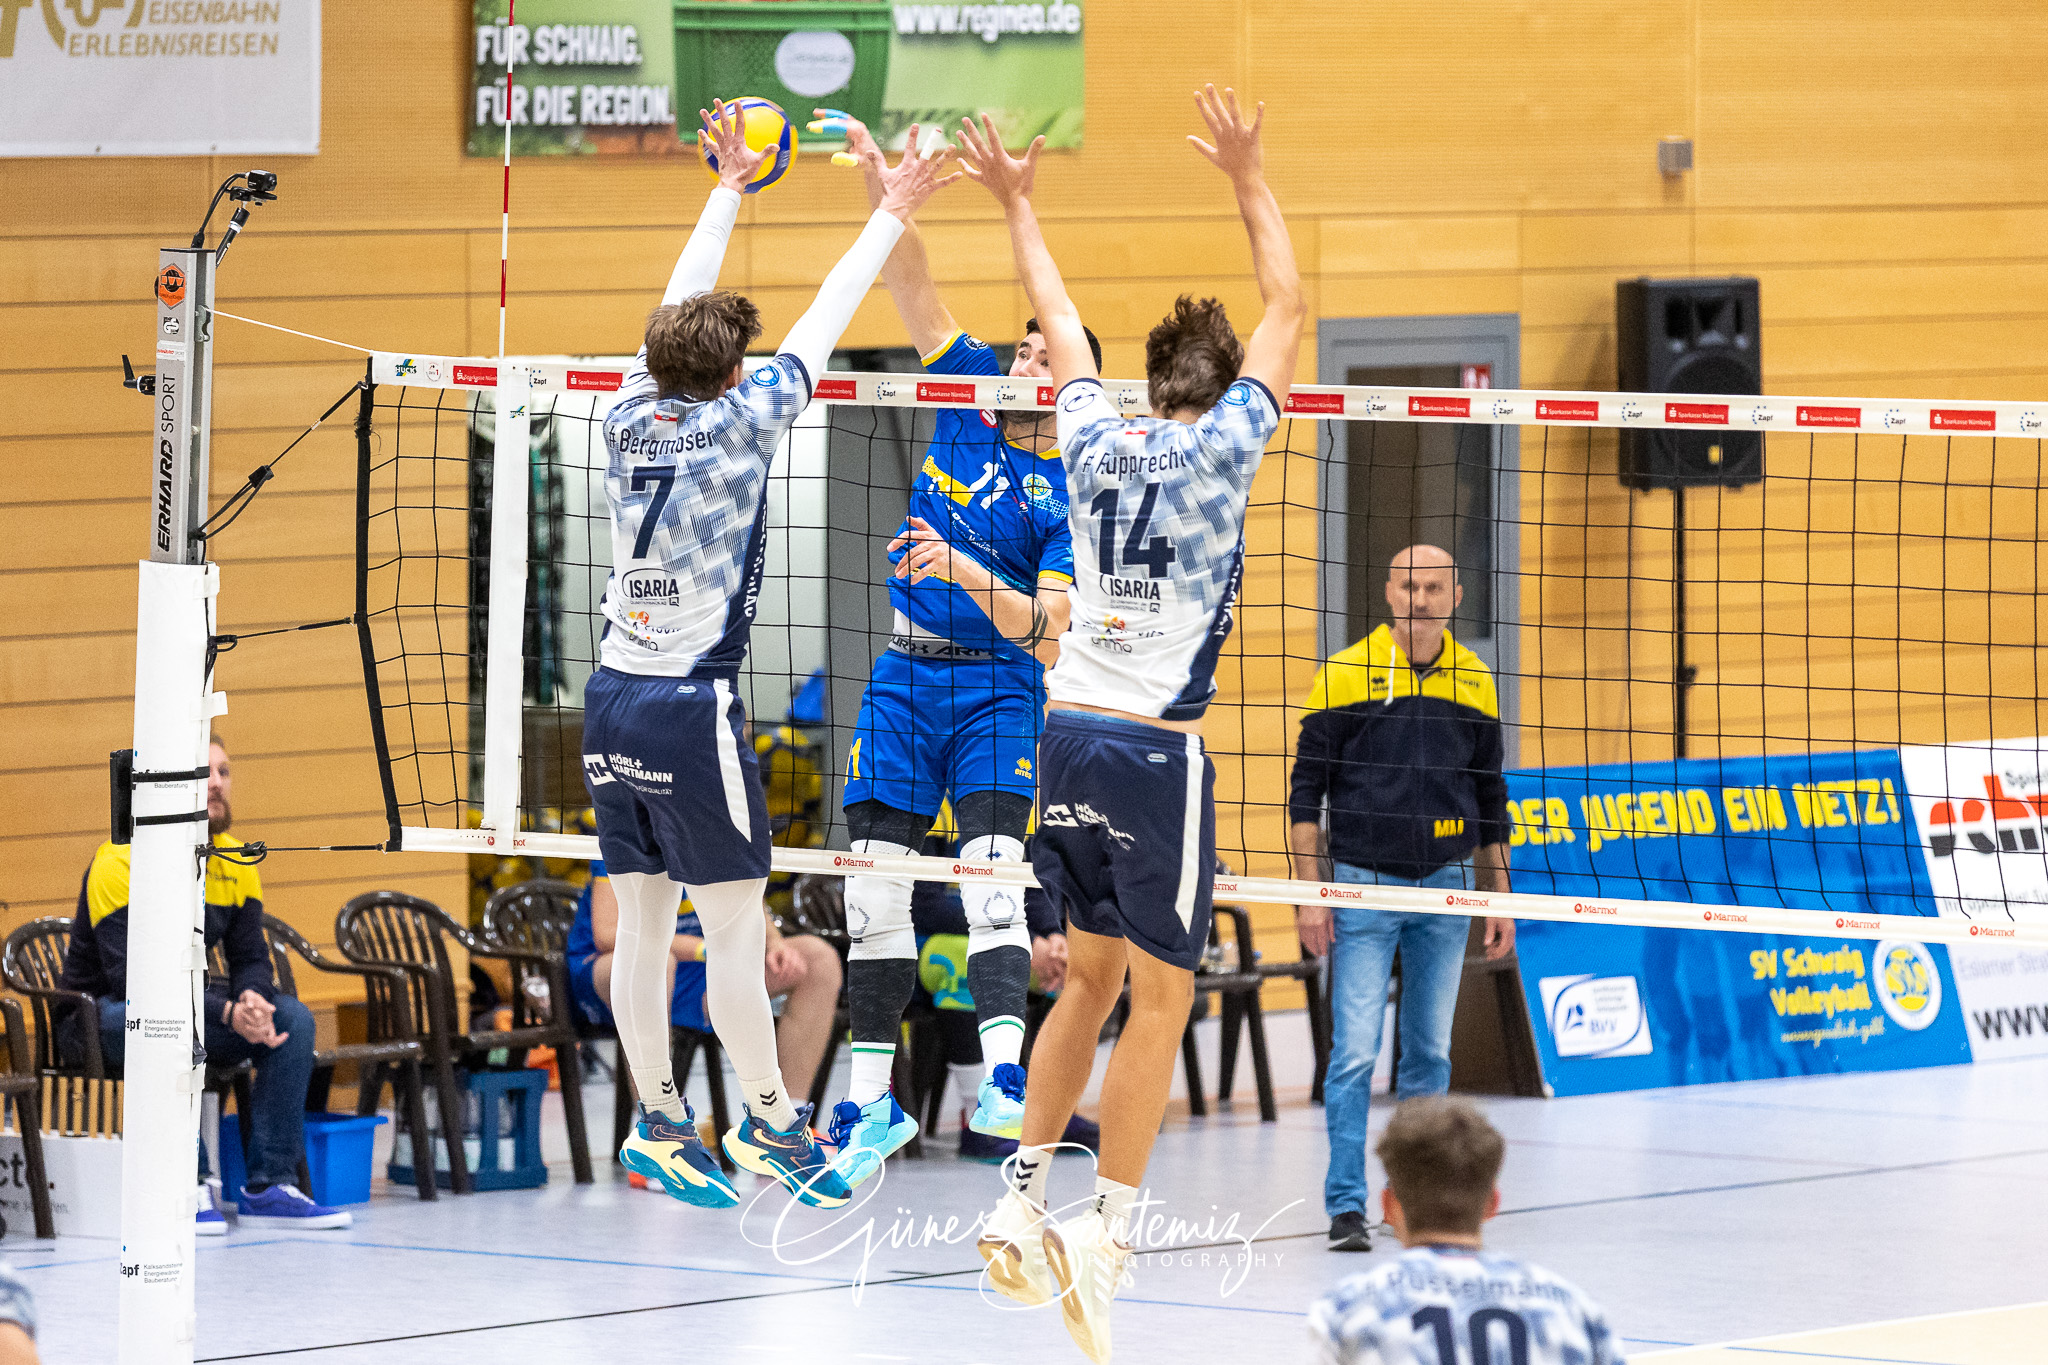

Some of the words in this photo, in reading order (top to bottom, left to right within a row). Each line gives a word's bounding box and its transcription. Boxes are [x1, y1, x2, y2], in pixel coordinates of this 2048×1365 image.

[149, 1, 279, 24] EISENBAHN
[67, 32, 279, 56] ERLEBNISREISEN
[476, 17, 530, 65] FÜR
[476, 77, 529, 126] FÜR
[532, 85, 577, 125] DIE
[580, 85, 676, 125] REGION.
[533, 378, 547, 386] Zapf
[1002, 393, 1016, 401] Zapf
[161, 374, 175, 433] SPORT
[1372, 404, 1387, 412] Zapf
[1498, 407, 1514, 415] Zapf
[1628, 411, 1643, 419] Zapf
[1758, 414, 1774, 422] Zapf
[1891, 417, 1906, 426] Zapf
[2026, 421, 2042, 429] Zapf
[158, 438, 173, 552] ERHARD
[631, 465, 676, 560] 7
[1090, 482, 1176, 578] 14
[629, 579, 680, 599] ISARIA
[1110, 578, 1161, 600] ISARIA
[609, 753, 643, 769] HÖRL+
[611, 763, 673, 783] HARTMANN
[154, 782, 188, 790] Bauberatung
[1580, 788, 1717, 853] JUGEND
[1722, 784, 1788, 834] EIN
[1791, 778, 1901, 829] NETZ!
[842, 857, 874, 868] Marmot
[962, 865, 994, 876] Marmot
[1212, 882, 1238, 892] armot
[1329, 889, 1362, 899] Marmot
[1455, 897, 1489, 907] Marmot
[1584, 905, 1618, 915] Marmot
[1714, 912, 1748, 923] Marmot
[1845, 919, 1880, 930] Marmot
[1980, 927, 2015, 937] Marmot
[125, 1018, 141, 1031] apf
[1412, 1304, 1527, 1365] 10
